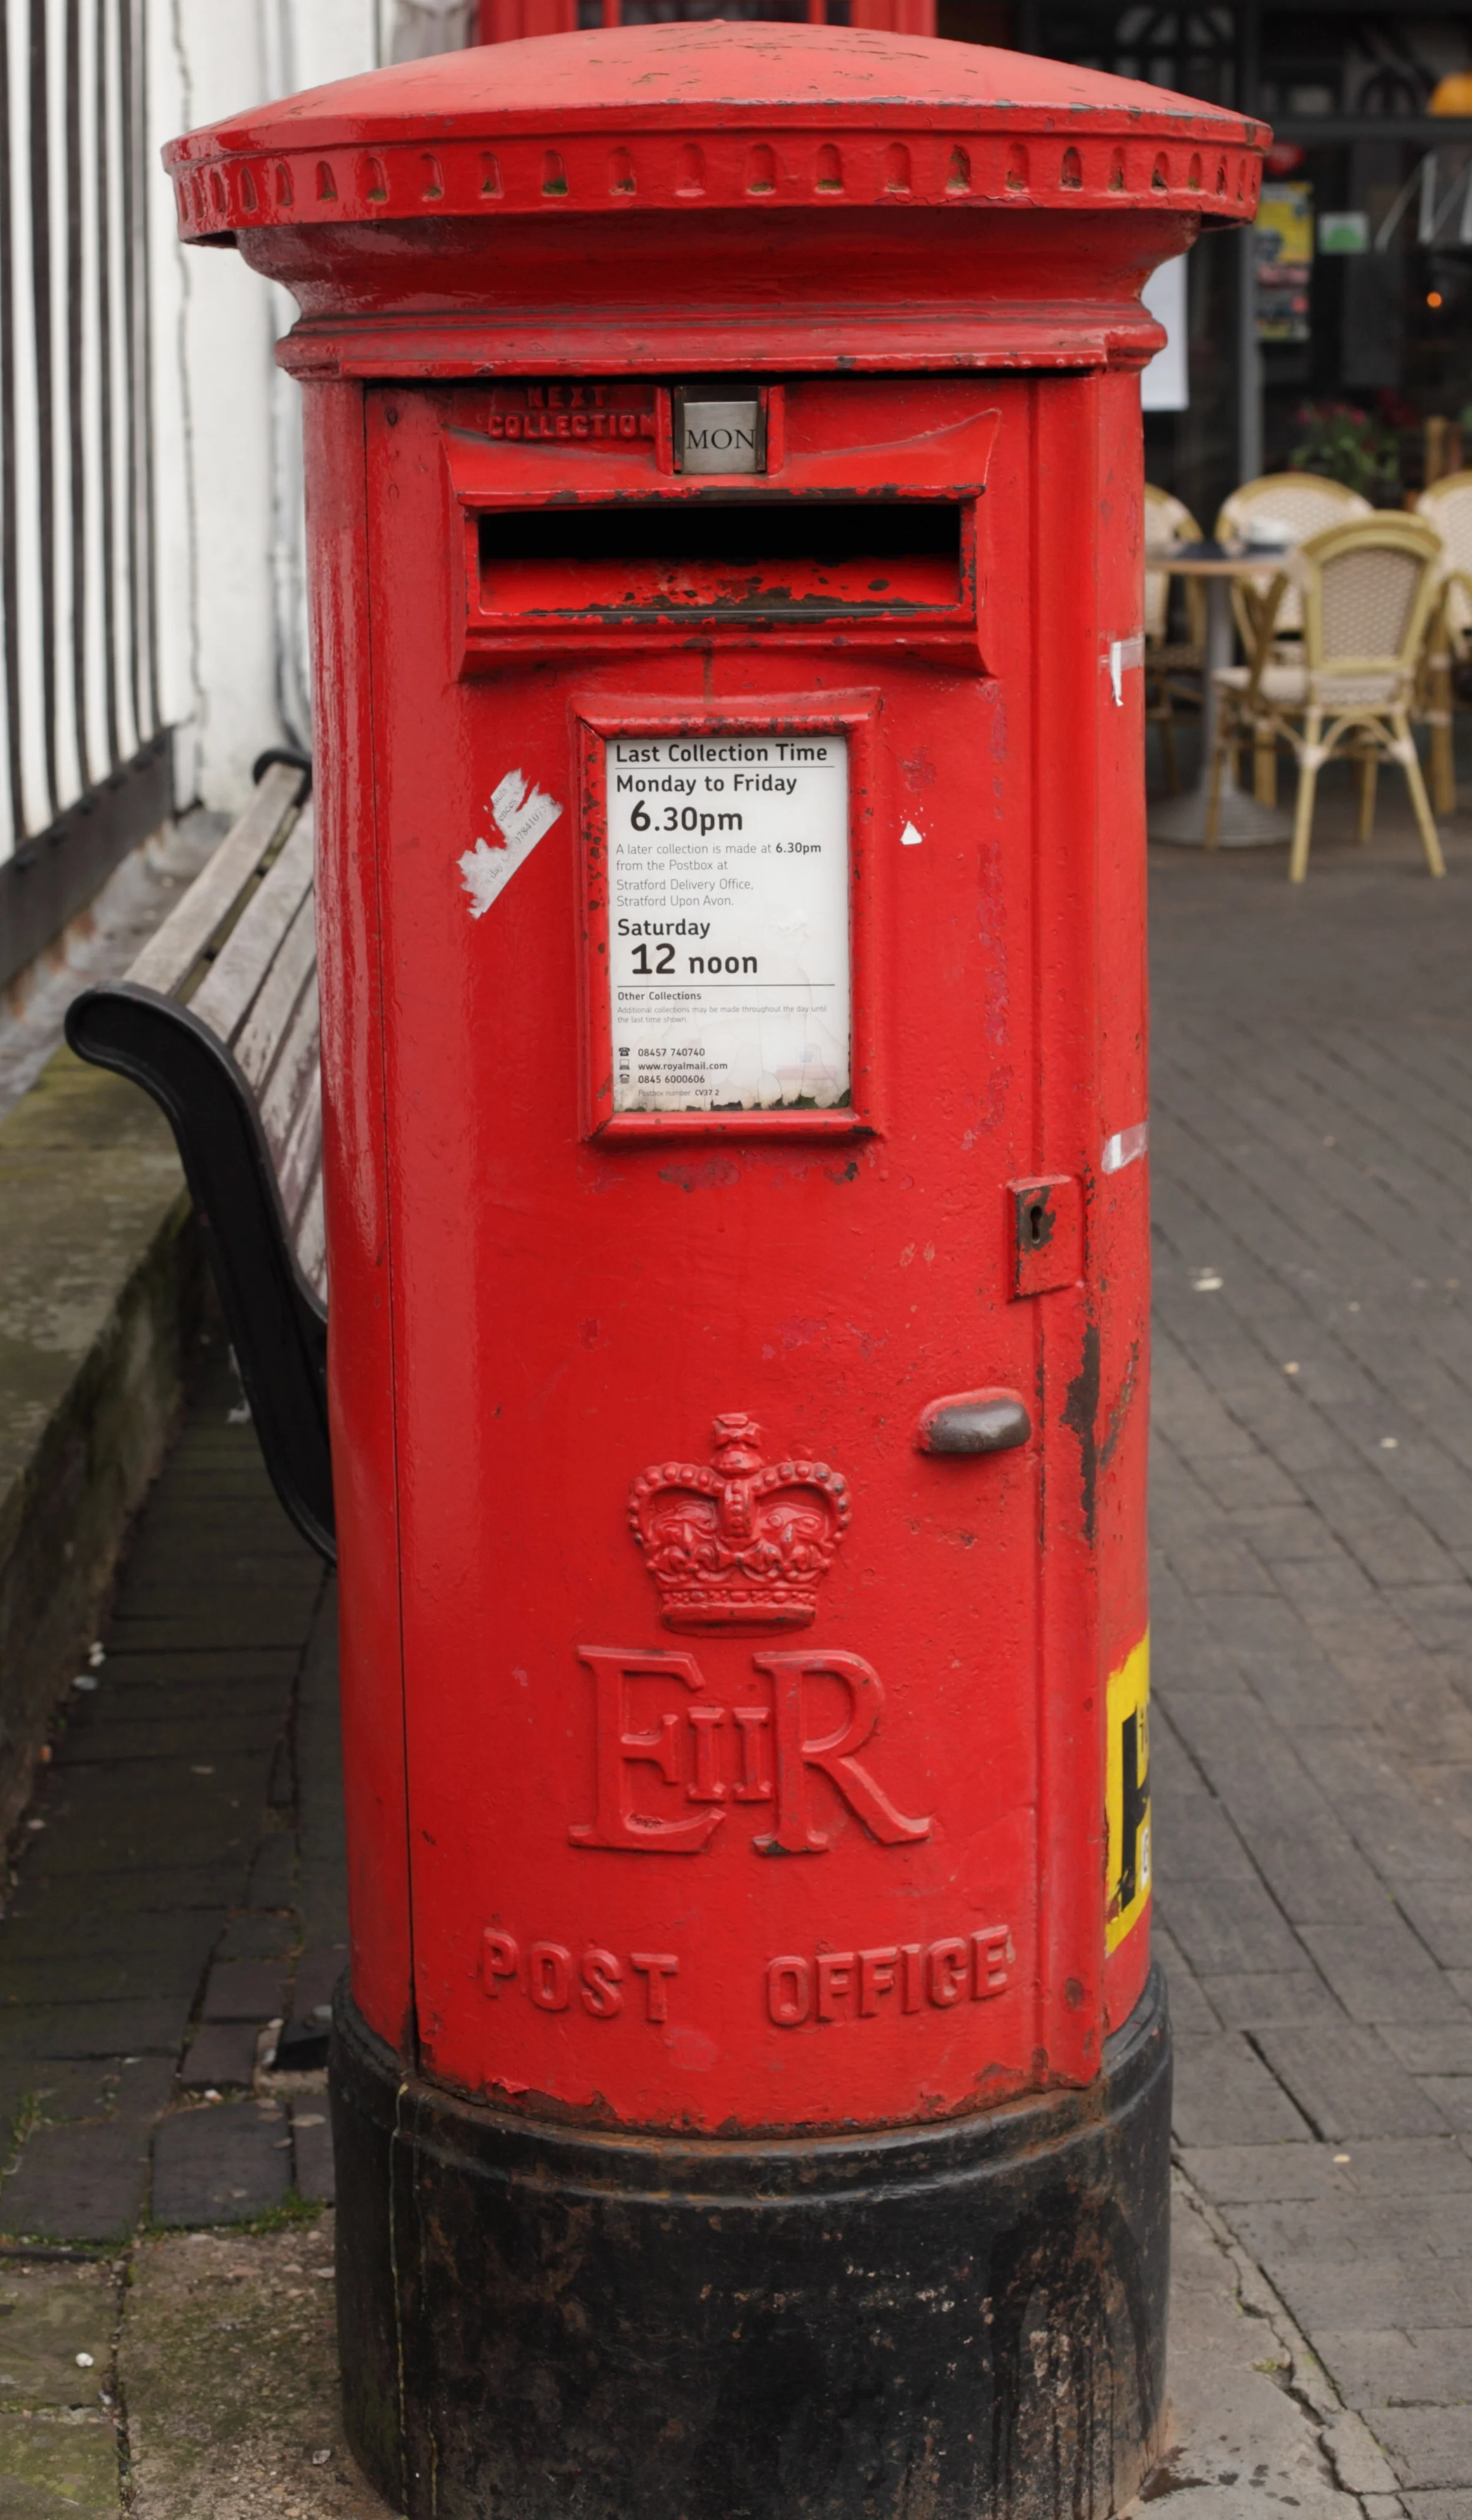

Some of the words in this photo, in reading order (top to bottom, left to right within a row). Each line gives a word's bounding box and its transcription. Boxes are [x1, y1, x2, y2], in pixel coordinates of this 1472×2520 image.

[685, 429, 756, 450] MON
[616, 744, 661, 762] Last
[668, 743, 768, 762] Collection
[775, 742, 827, 761] Time
[616, 774, 697, 796] Monday
[704, 775, 725, 792] to
[734, 773, 797, 795] Friday
[630, 800, 742, 837] 6.30pm
[616, 843, 624, 854] A
[628, 844, 653, 854] later
[657, 843, 708, 854] collection
[712, 843, 721, 854] is
[725, 843, 757, 854] made
[761, 843, 771, 854] at
[775, 842, 821, 856] 6.30pm
[616, 860, 643, 871] from
[647, 860, 665, 871] the
[669, 859, 713, 871] Postbox
[717, 860, 728, 870] at
[616, 878, 666, 890] Stratford
[670, 878, 715, 892] Delivery
[720, 878, 754, 890] Office,
[616, 895, 666, 907] Stratford
[670, 895, 700, 908] Upon
[702, 894, 734, 906] Avon.
[618, 918, 711, 940] Saturday
[631, 943, 676, 975] 12
[688, 956, 758, 974] noon
[618, 992, 645, 1001] Other
[649, 991, 702, 1000] Collections
[692, 1007, 708, 1015] may
[742, 1006, 781, 1014] throughout
[796, 1006, 809, 1014] day
[638, 1048, 667, 1057] 08457
[671, 1047, 705, 1057] 740740
[638, 1062, 728, 1072] www.royalmail.com
[638, 1075, 661, 1084] 0845
[664, 1075, 705, 1084] 6000606
[482, 1927, 679, 2023] POST
[765, 1923, 1010, 2028] OFFICE
